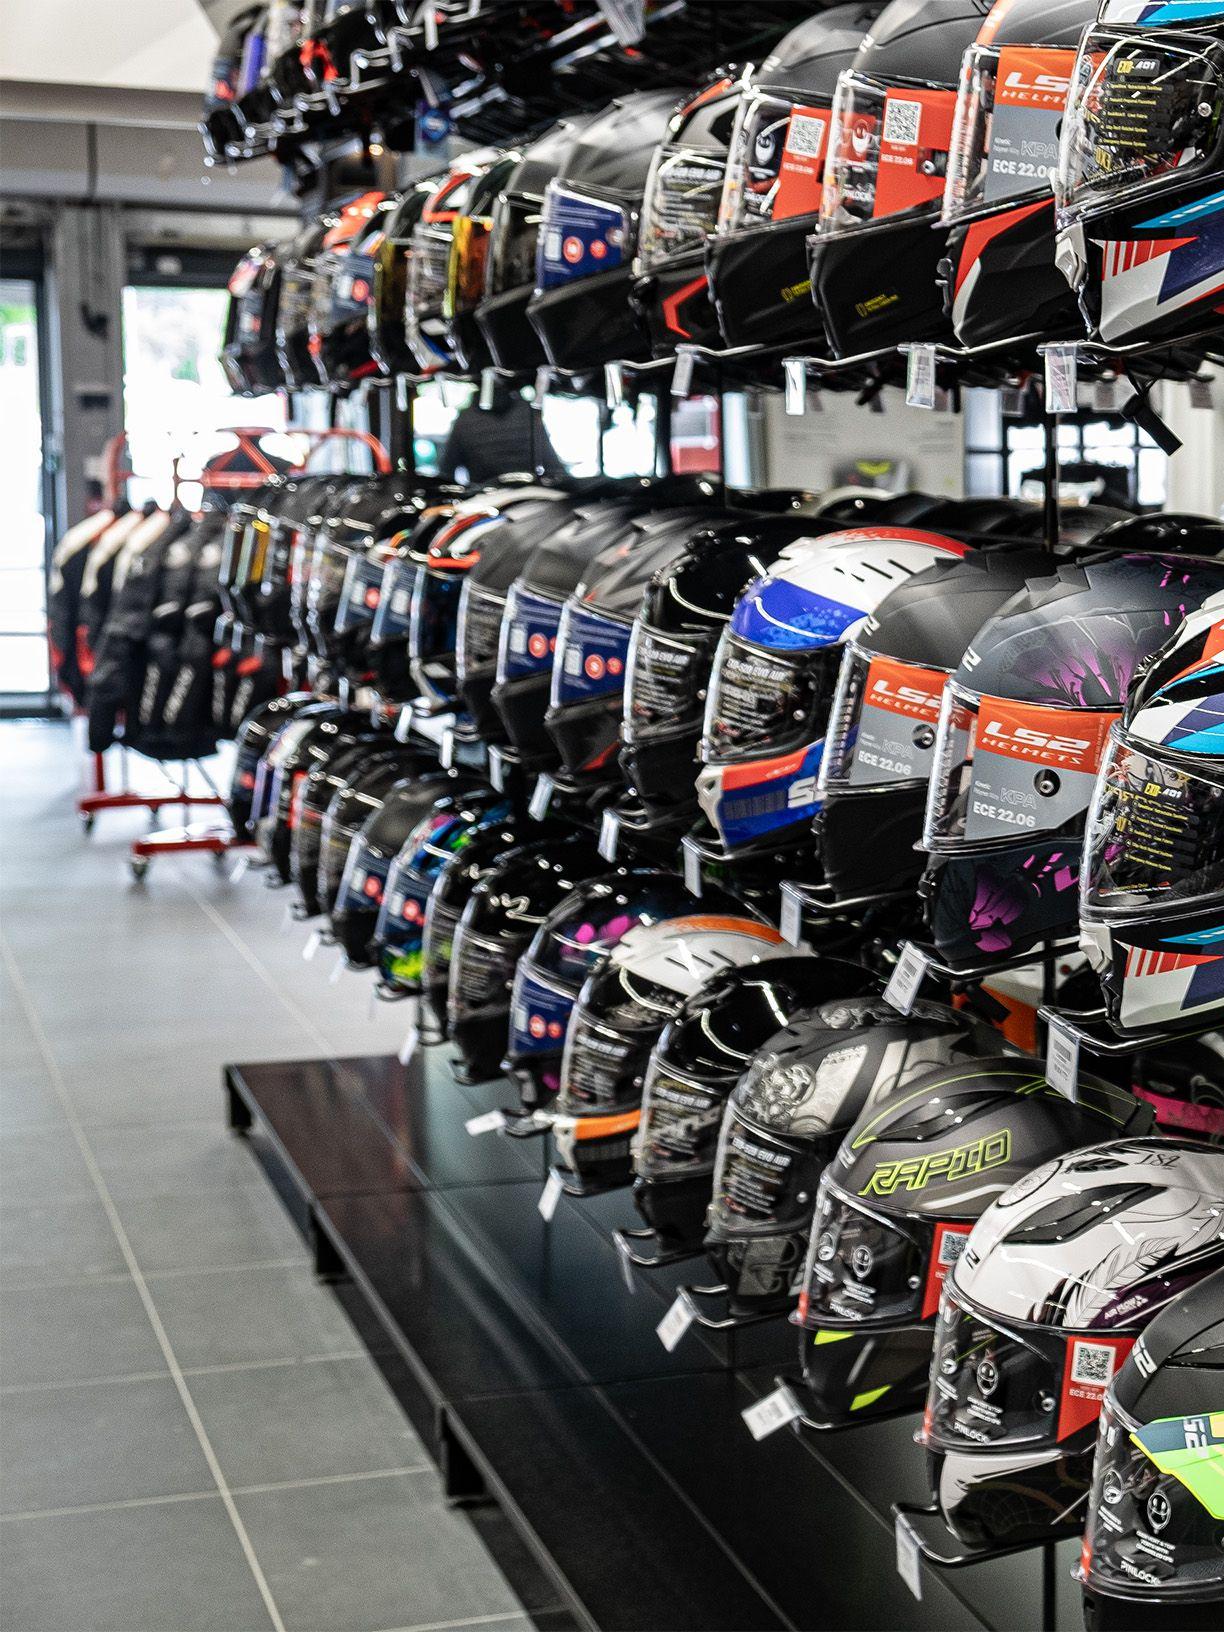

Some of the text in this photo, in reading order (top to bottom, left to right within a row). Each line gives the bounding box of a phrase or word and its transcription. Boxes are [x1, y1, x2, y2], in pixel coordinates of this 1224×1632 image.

[1005, 71, 1070, 93] LS
[1002, 90, 1067, 103] HELM
[993, 159, 1016, 175] ECE
[870, 693, 941, 718] HELME
[985, 720, 1091, 755] LS2
[859, 750, 912, 776] ECE 22.06
[982, 737, 1081, 766] HELMETS
[973, 801, 1036, 828] ECE 22.06
[858, 1128, 1012, 1196] RAPID
[1086, 1390, 1106, 1401] 22.0
